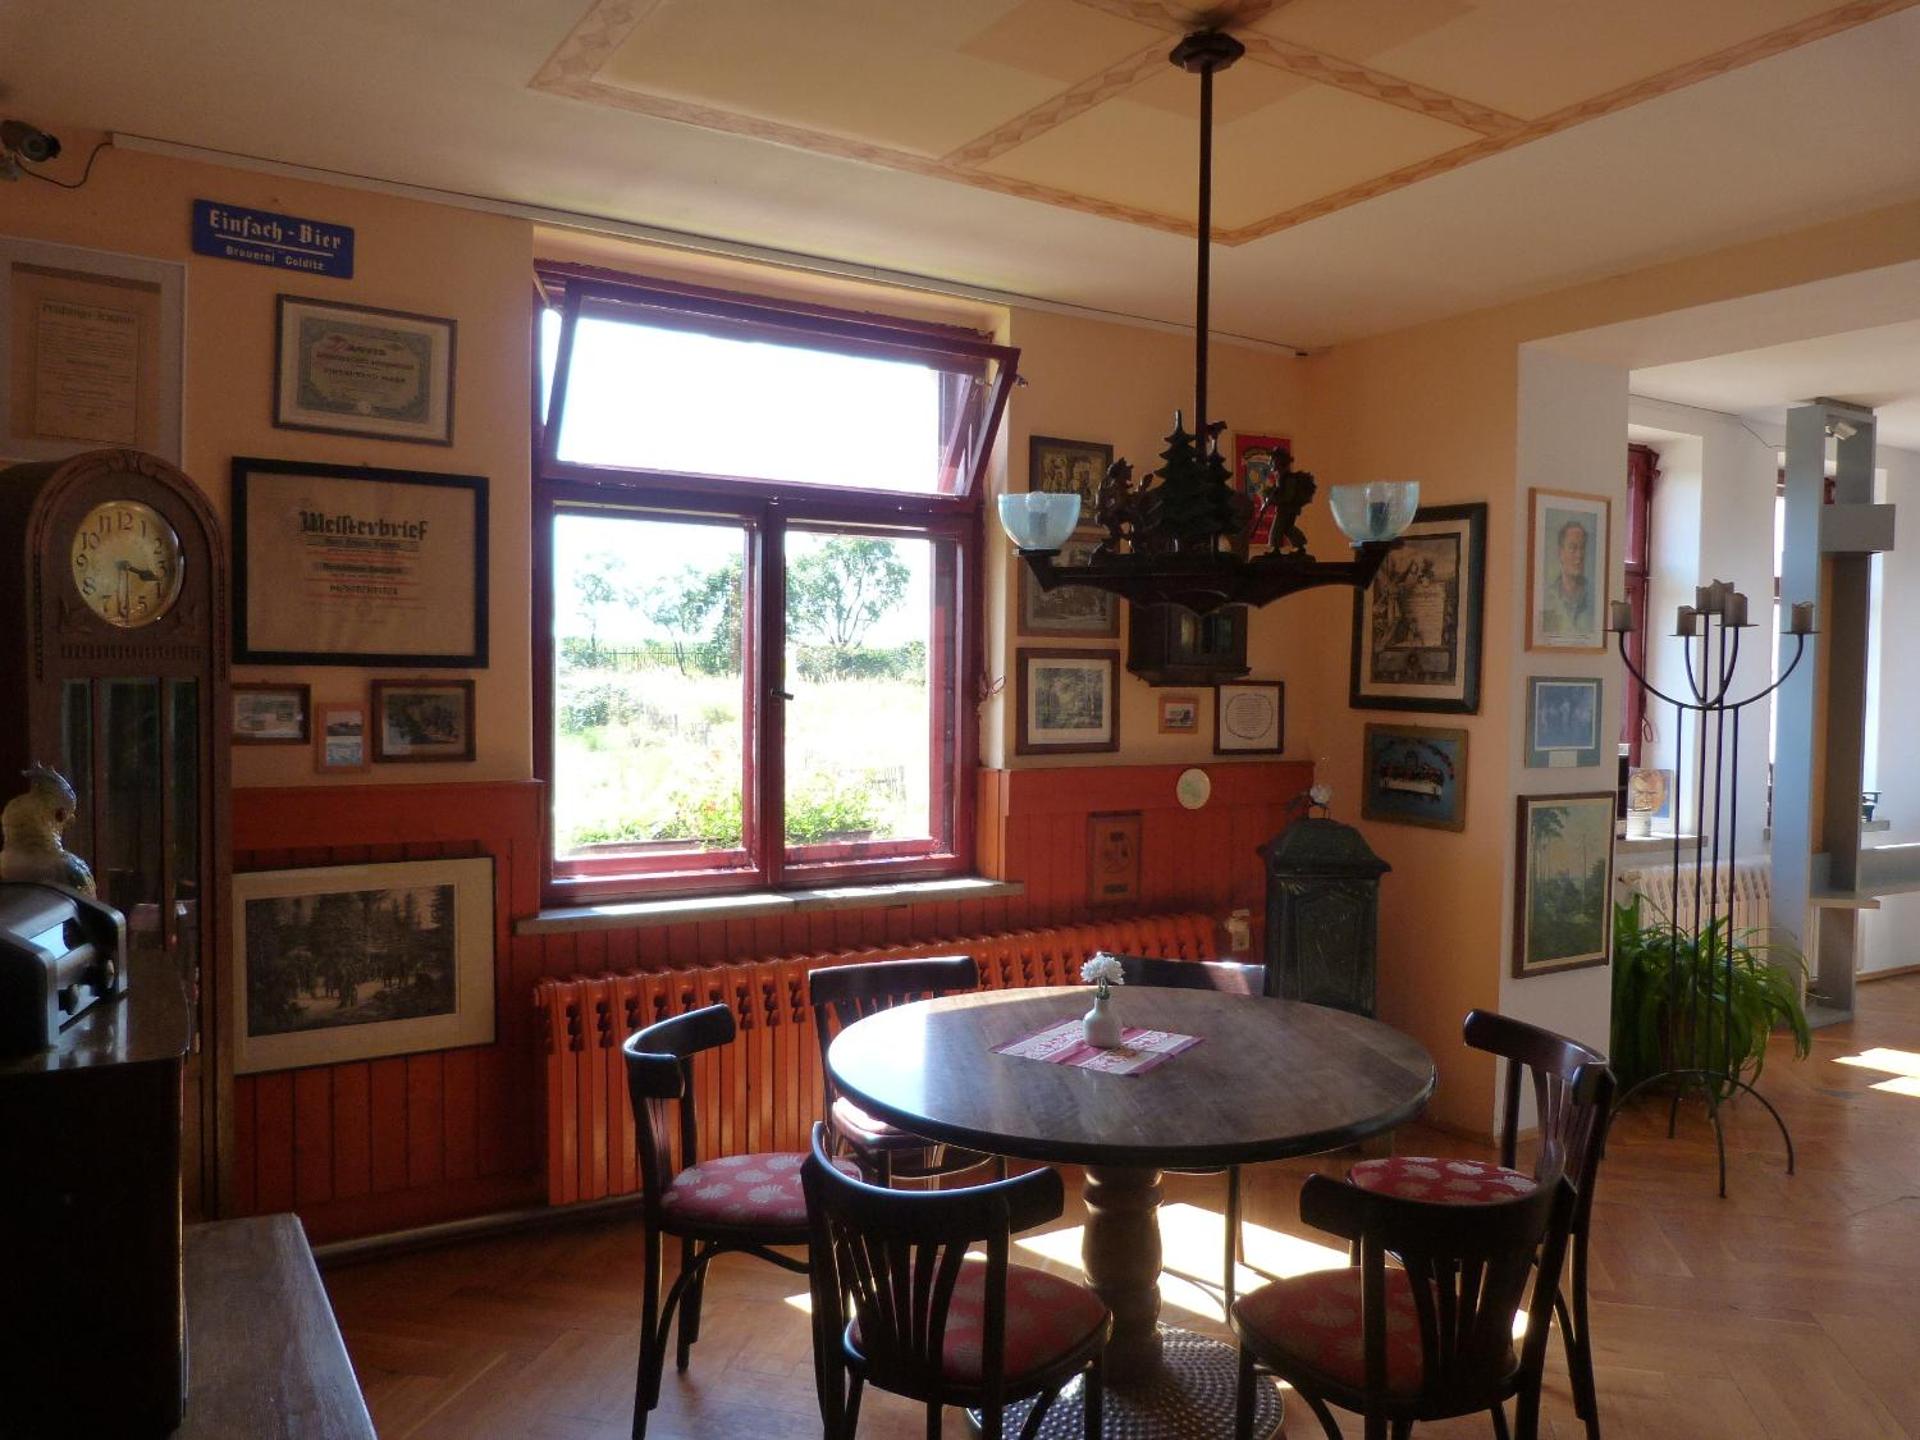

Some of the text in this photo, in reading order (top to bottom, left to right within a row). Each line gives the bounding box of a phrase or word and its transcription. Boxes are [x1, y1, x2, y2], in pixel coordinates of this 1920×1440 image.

[99, 515, 112, 534] 11
[117, 511, 133, 531] 12
[141, 520, 147, 539] 1
[298, 510, 429, 541] Meisterbrief
[81, 531, 100, 551] 10
[153, 537, 163, 556] 2
[76, 552, 88, 568] 9
[83, 577, 95, 595] 8
[102, 594, 112, 613] 7
